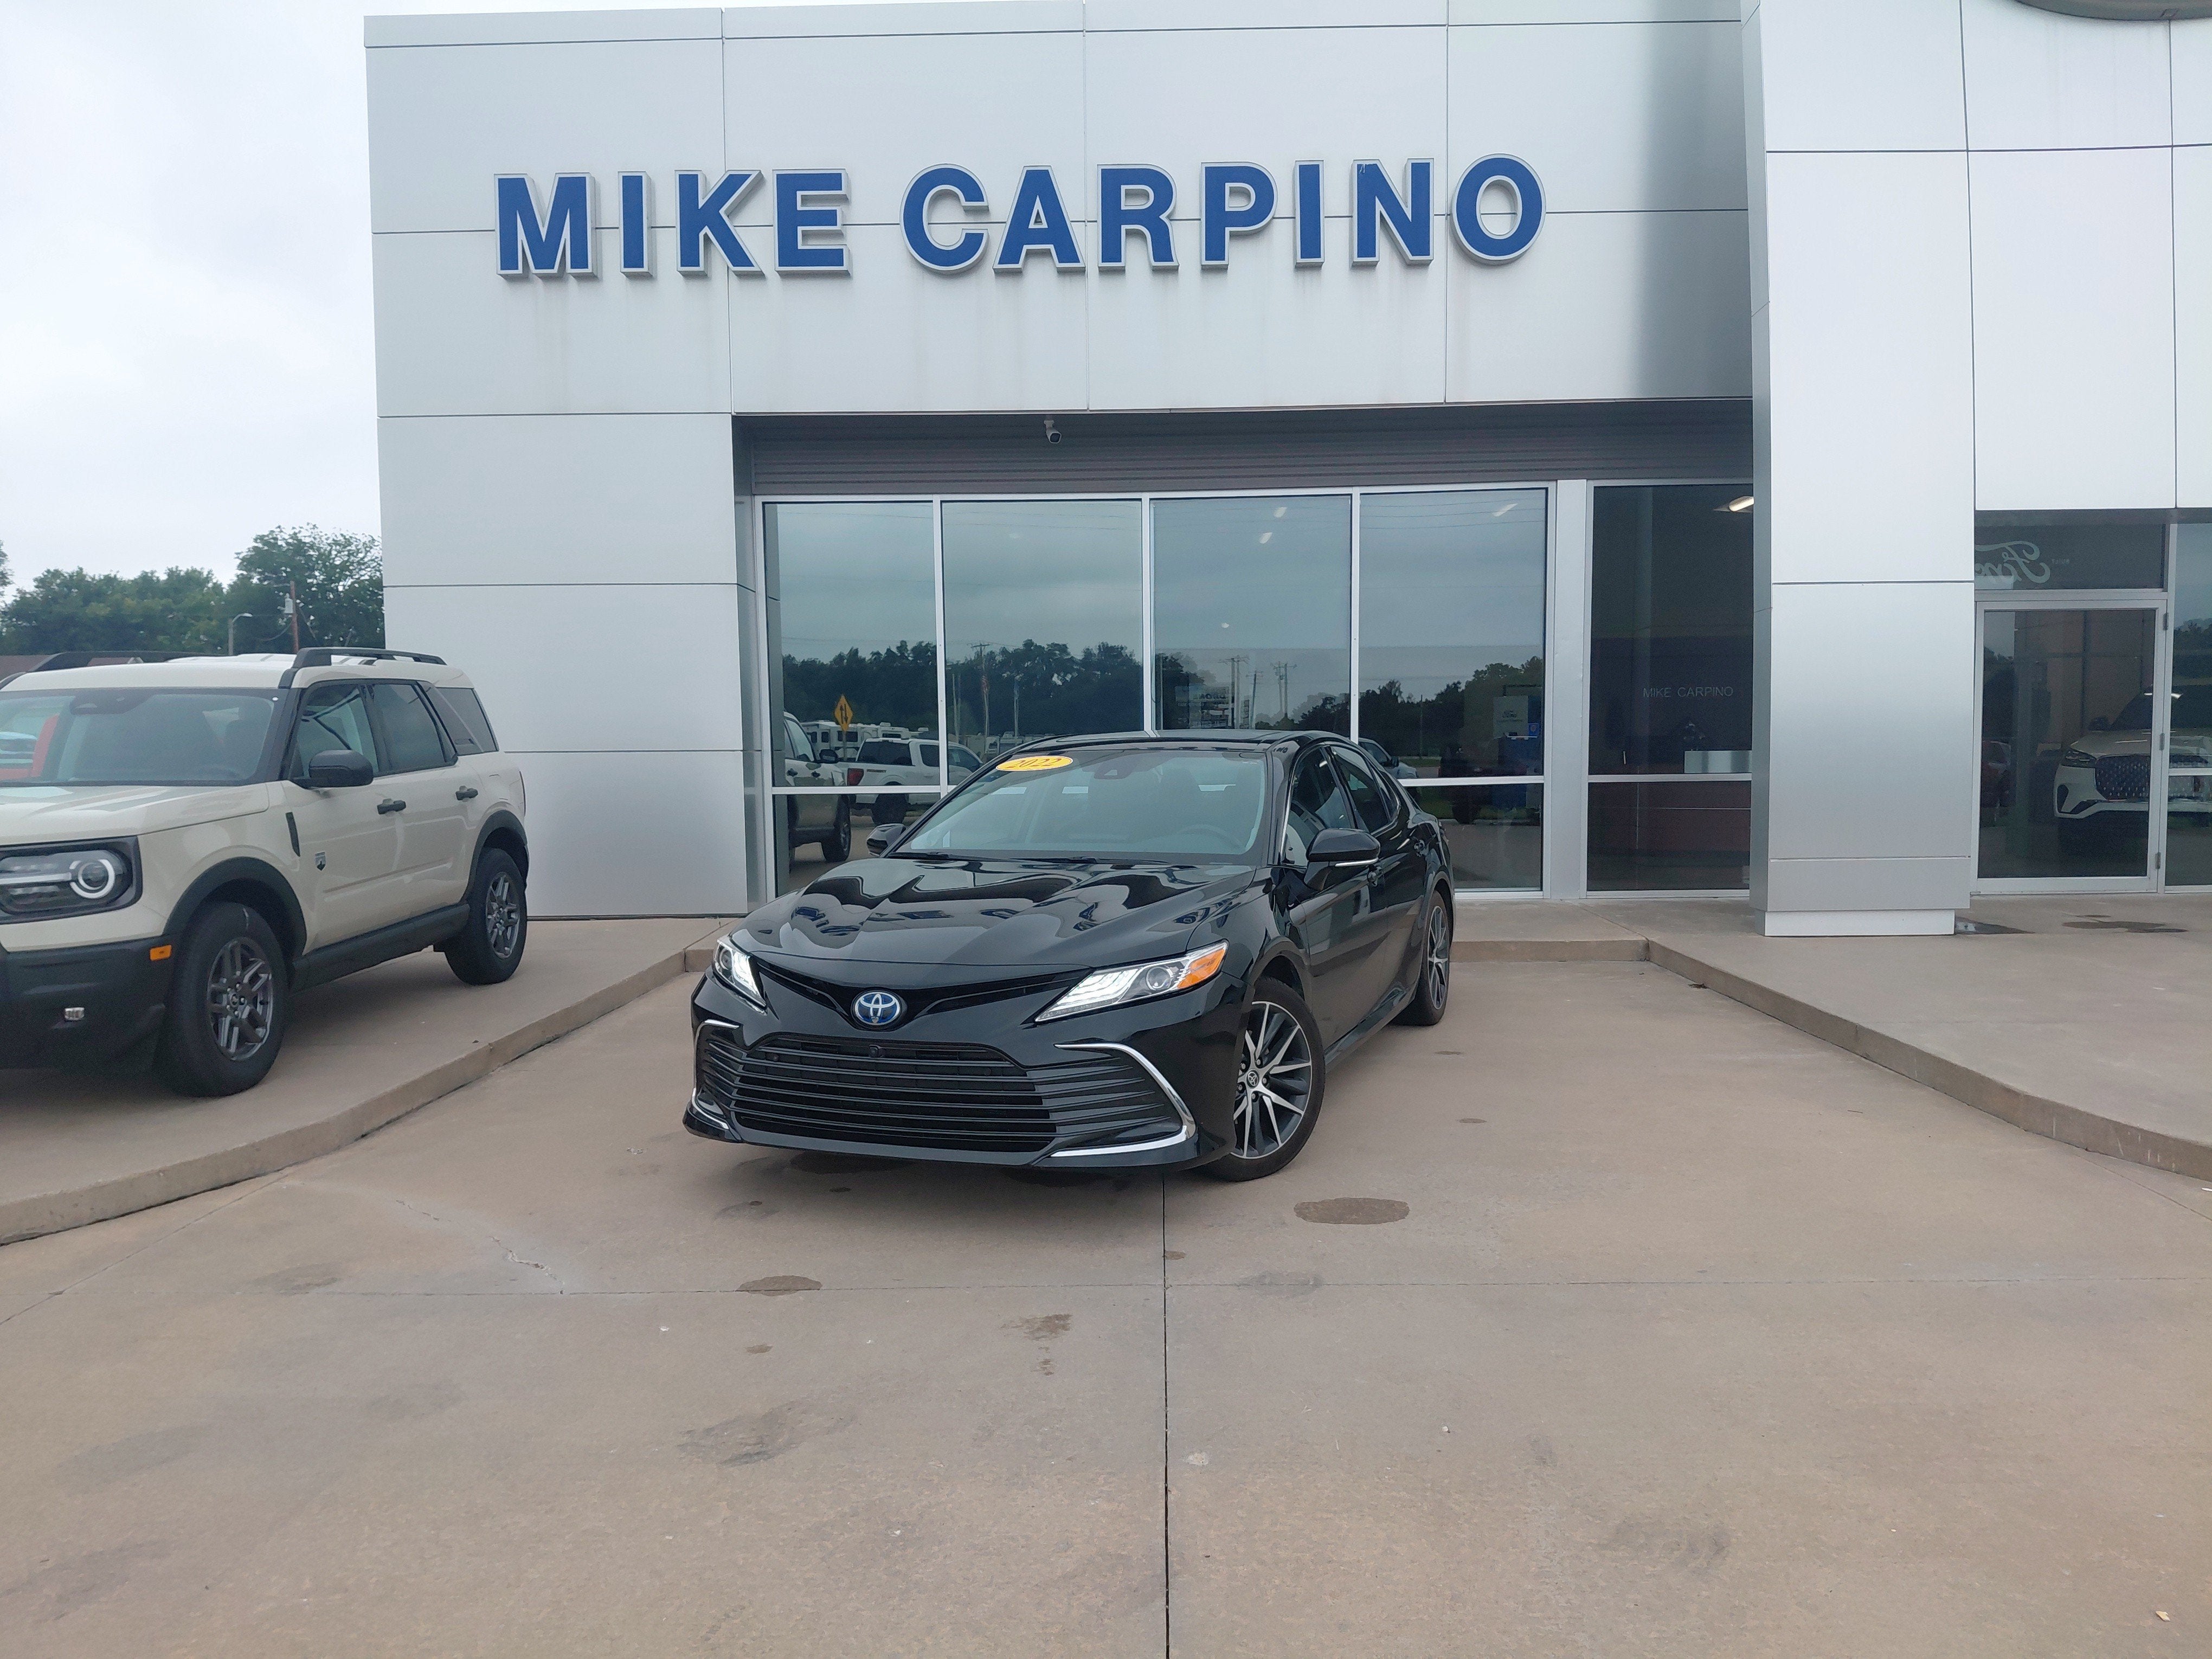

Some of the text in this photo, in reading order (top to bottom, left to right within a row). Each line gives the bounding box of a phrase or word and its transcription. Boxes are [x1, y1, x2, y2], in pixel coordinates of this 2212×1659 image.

[494, 153, 1546, 276] MIKE CARPINO
[1643, 686, 1734, 698] MIKE CARPINO
[1005, 758, 1062, 769] 2022
